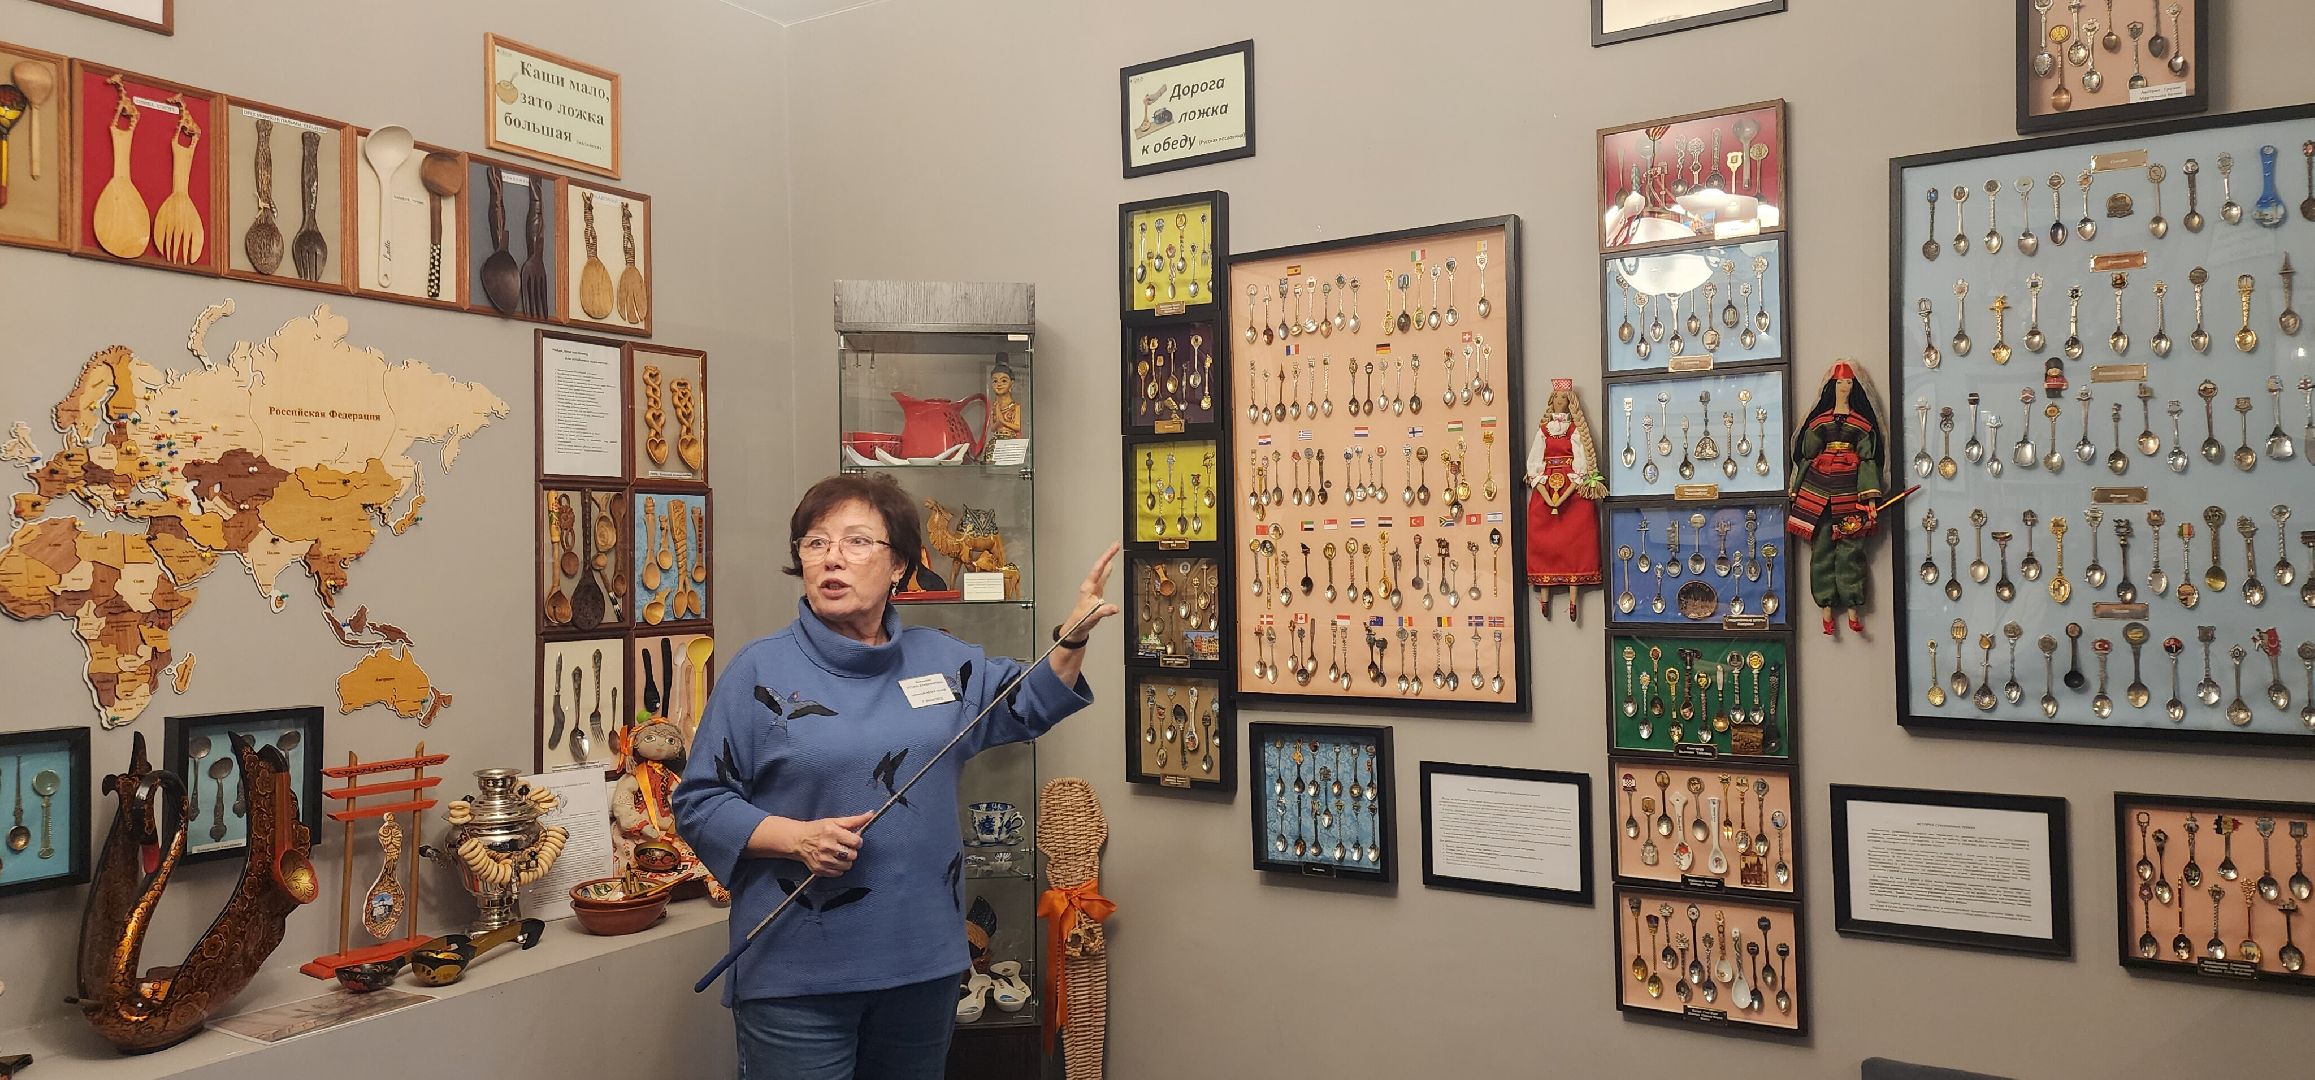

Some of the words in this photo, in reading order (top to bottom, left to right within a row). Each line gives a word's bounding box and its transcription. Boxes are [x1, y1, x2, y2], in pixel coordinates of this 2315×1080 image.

[520, 60, 565, 88] Каши
[569, 79, 610, 103] мало,
[1169, 77, 1225, 102] Дорога
[520, 92, 552, 111] зато
[557, 103, 605, 126] ложка
[1178, 102, 1229, 124] ложка
[504, 112, 572, 142] большая
[1141, 144, 1150, 156] к
[1153, 134, 1197, 154] обеду
[269, 406, 326, 418] Российская
[329, 409, 381, 422] Федерация
